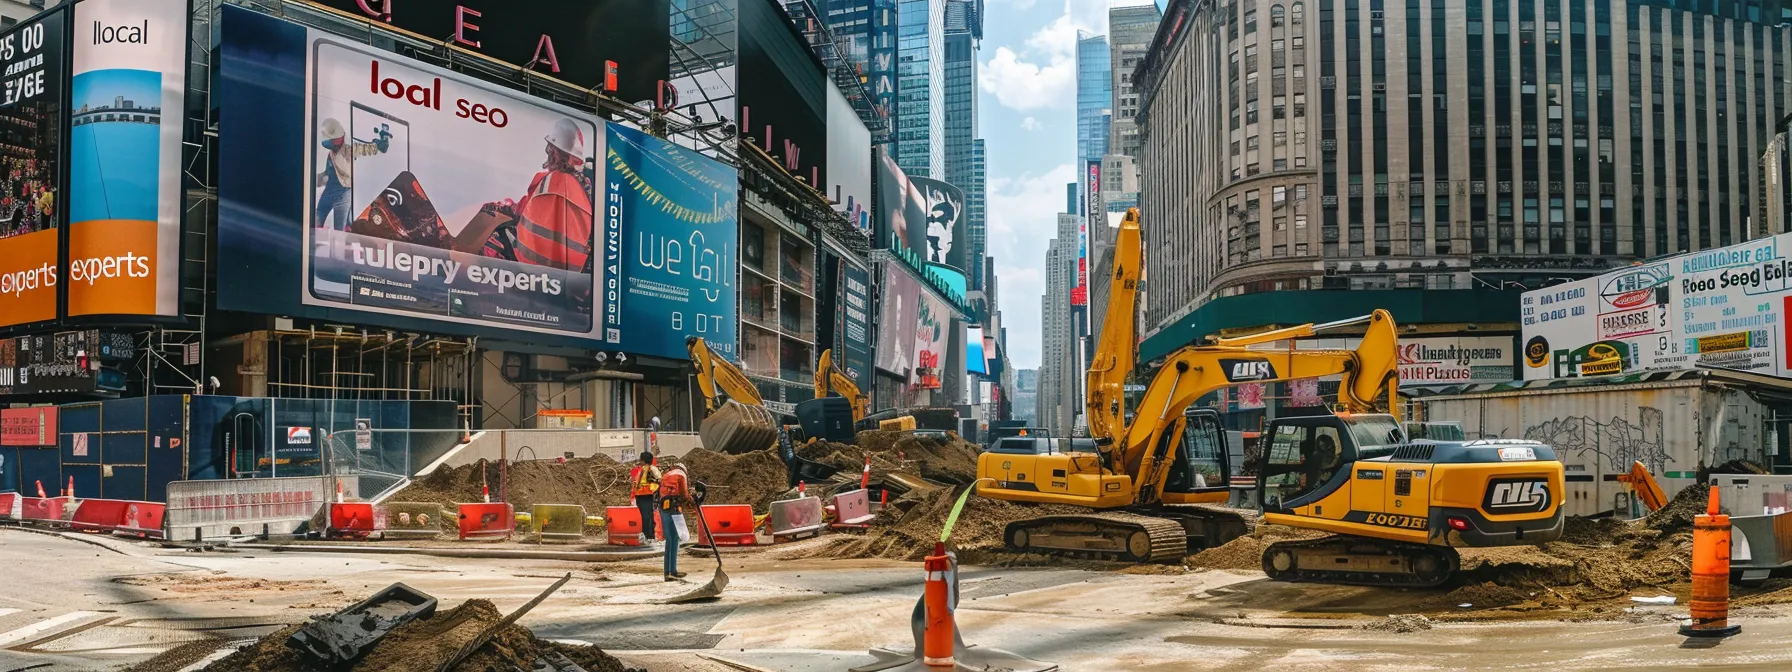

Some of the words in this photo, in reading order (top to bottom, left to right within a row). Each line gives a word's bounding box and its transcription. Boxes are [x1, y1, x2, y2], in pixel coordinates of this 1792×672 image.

[371, 60, 441, 111] loal
[455, 98, 508, 128] seo
[71, 251, 149, 286] experts
[467, 263, 562, 296] experts
